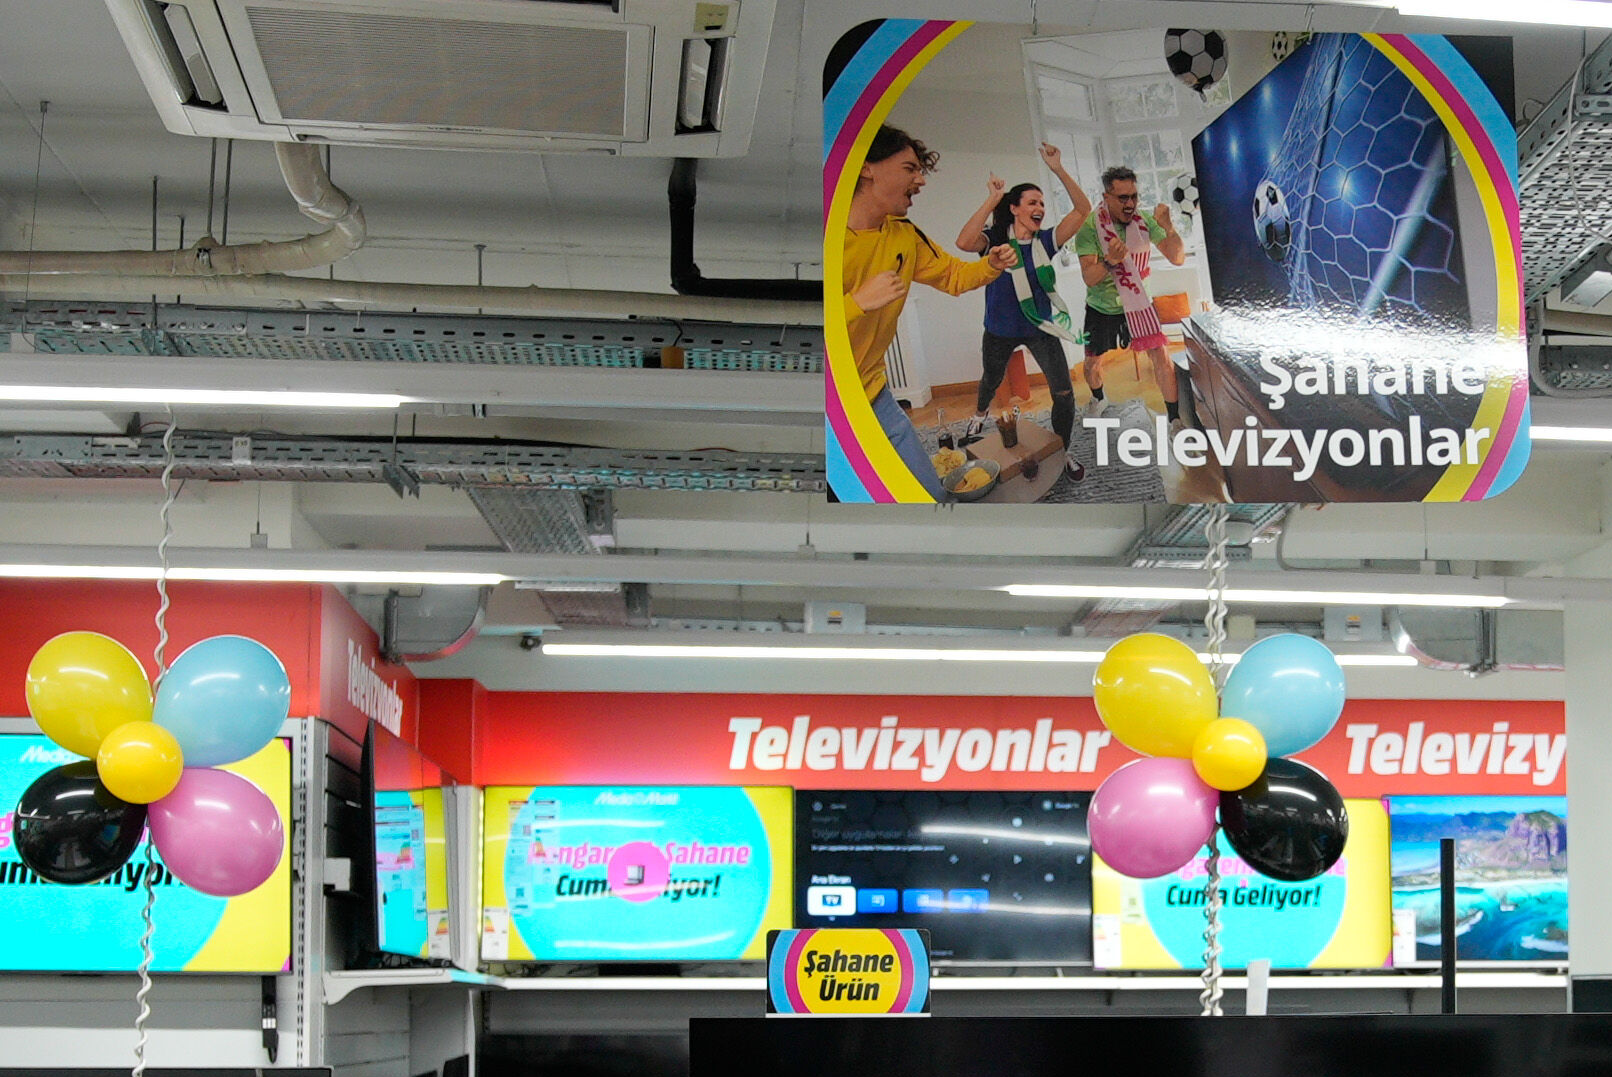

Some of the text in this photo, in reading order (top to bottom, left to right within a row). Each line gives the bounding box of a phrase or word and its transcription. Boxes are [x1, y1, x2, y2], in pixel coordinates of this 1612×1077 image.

[1083, 415, 1490, 481] Televizyonlar
[728, 715, 1112, 783] Televizyonlar
[1234, 883, 1322, 911] Geliyor!
[804, 950, 894, 978] Şahane
[818, 975, 880, 1002] Ürün
